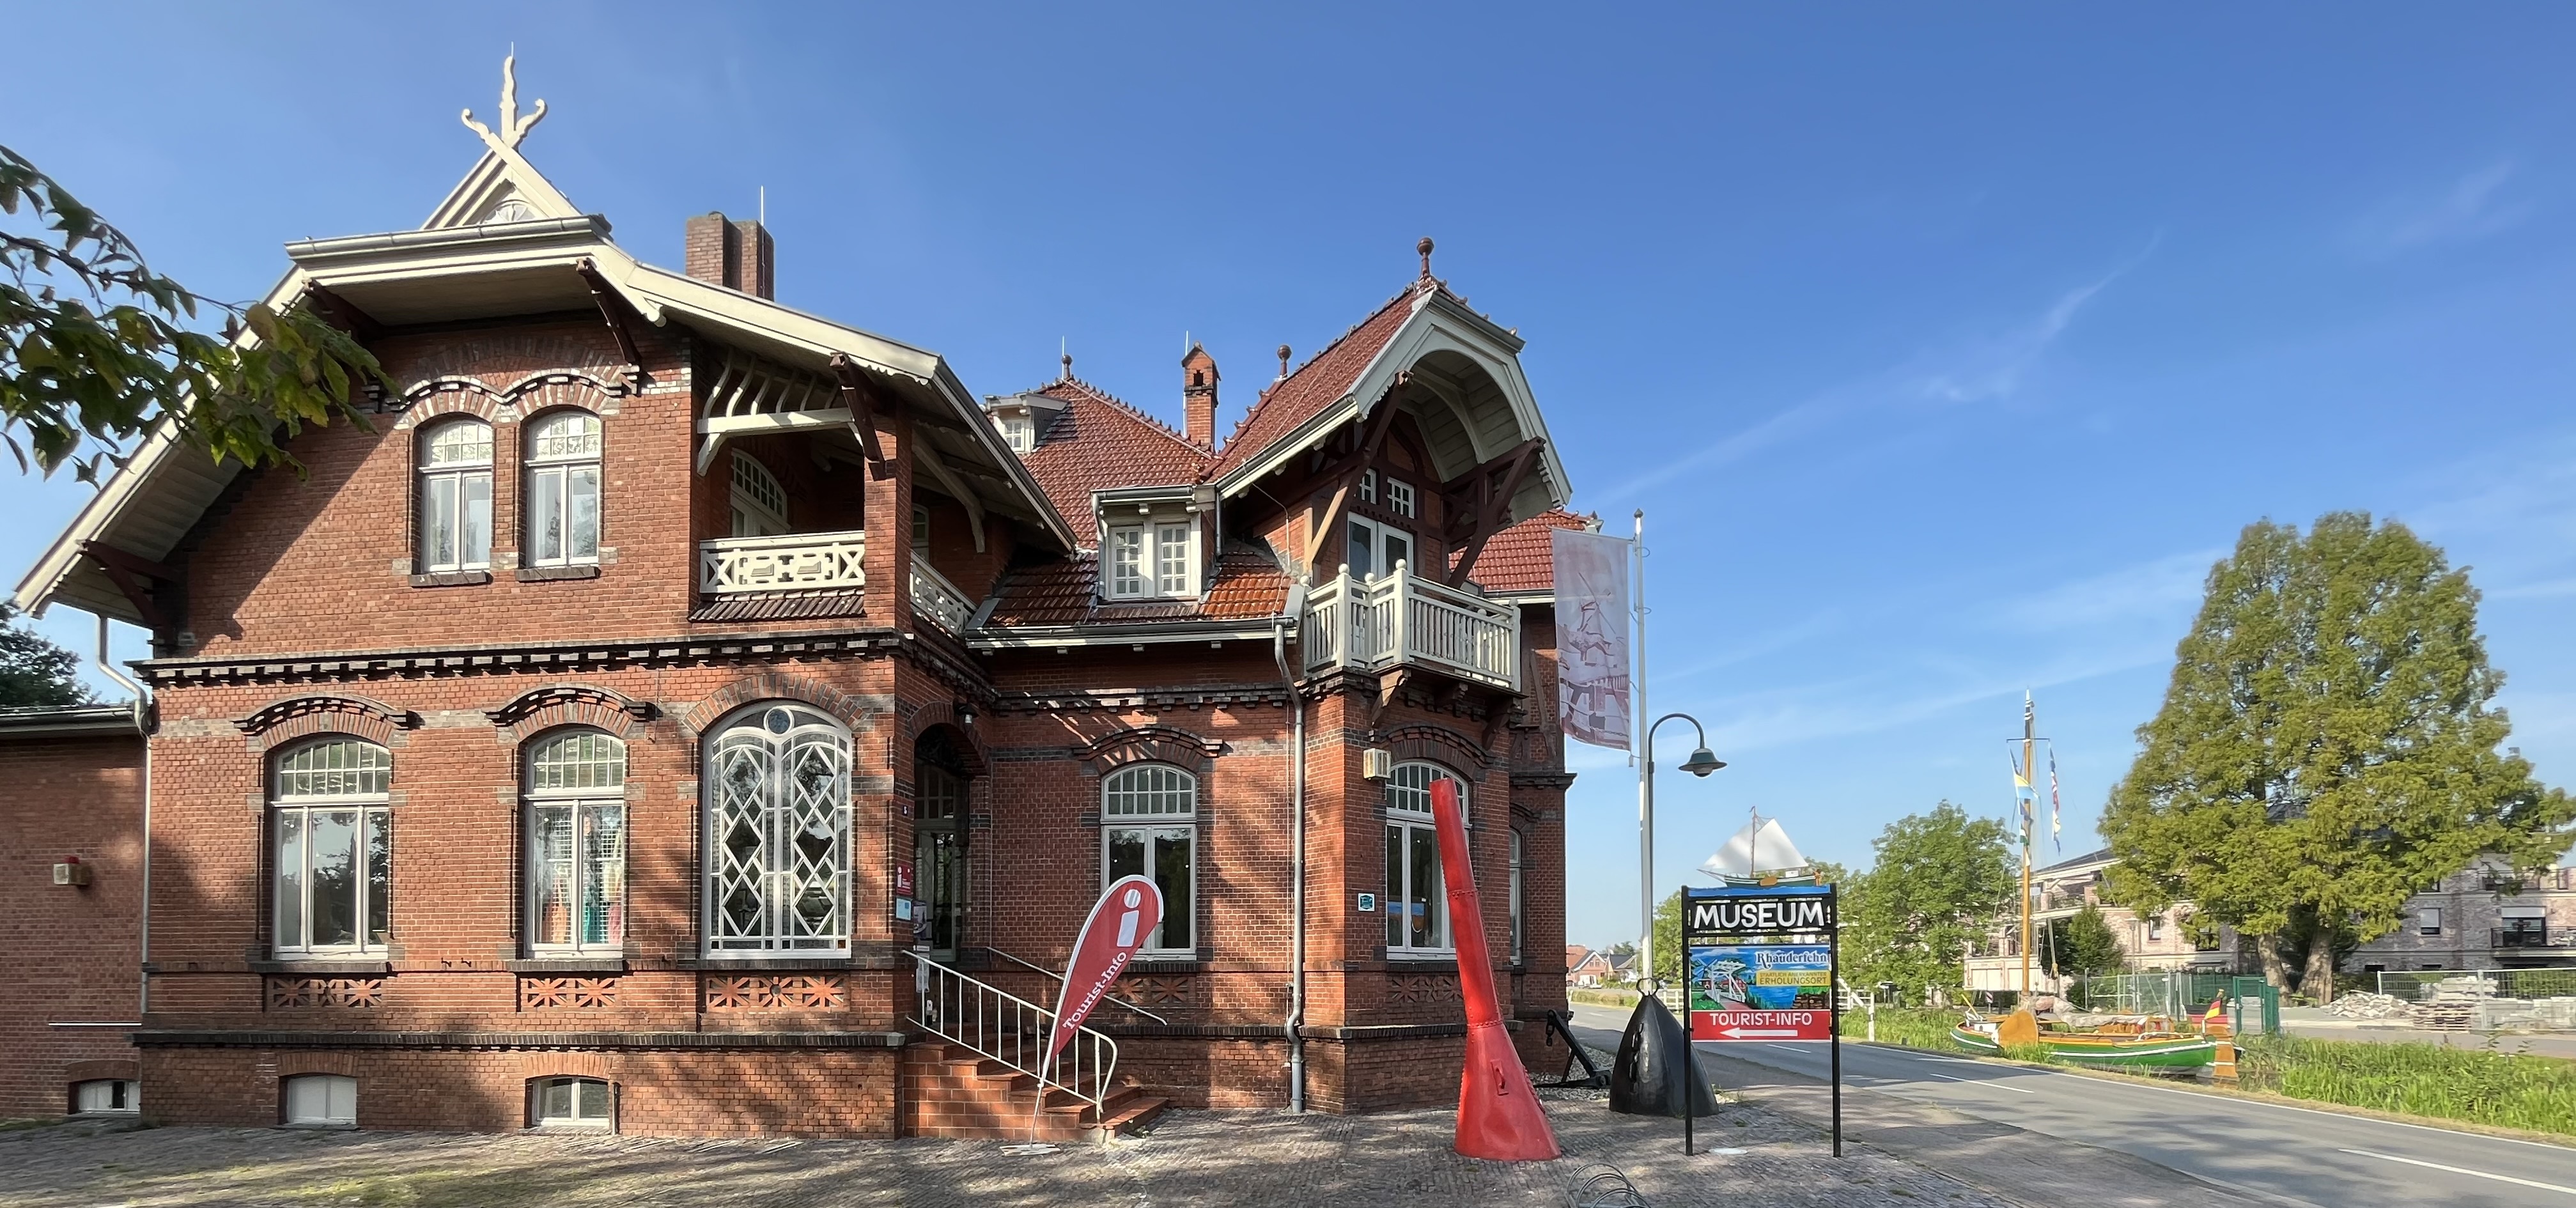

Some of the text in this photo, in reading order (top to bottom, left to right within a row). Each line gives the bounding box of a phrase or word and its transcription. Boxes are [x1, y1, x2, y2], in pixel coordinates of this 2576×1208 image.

[1694, 902, 1824, 929] MUSEUM
[1757, 950, 1827, 969] Rhauderfehn
[1062, 952, 1127, 1029] Tourist-Info
[1710, 1013, 1812, 1025] TOURIST-INFO
